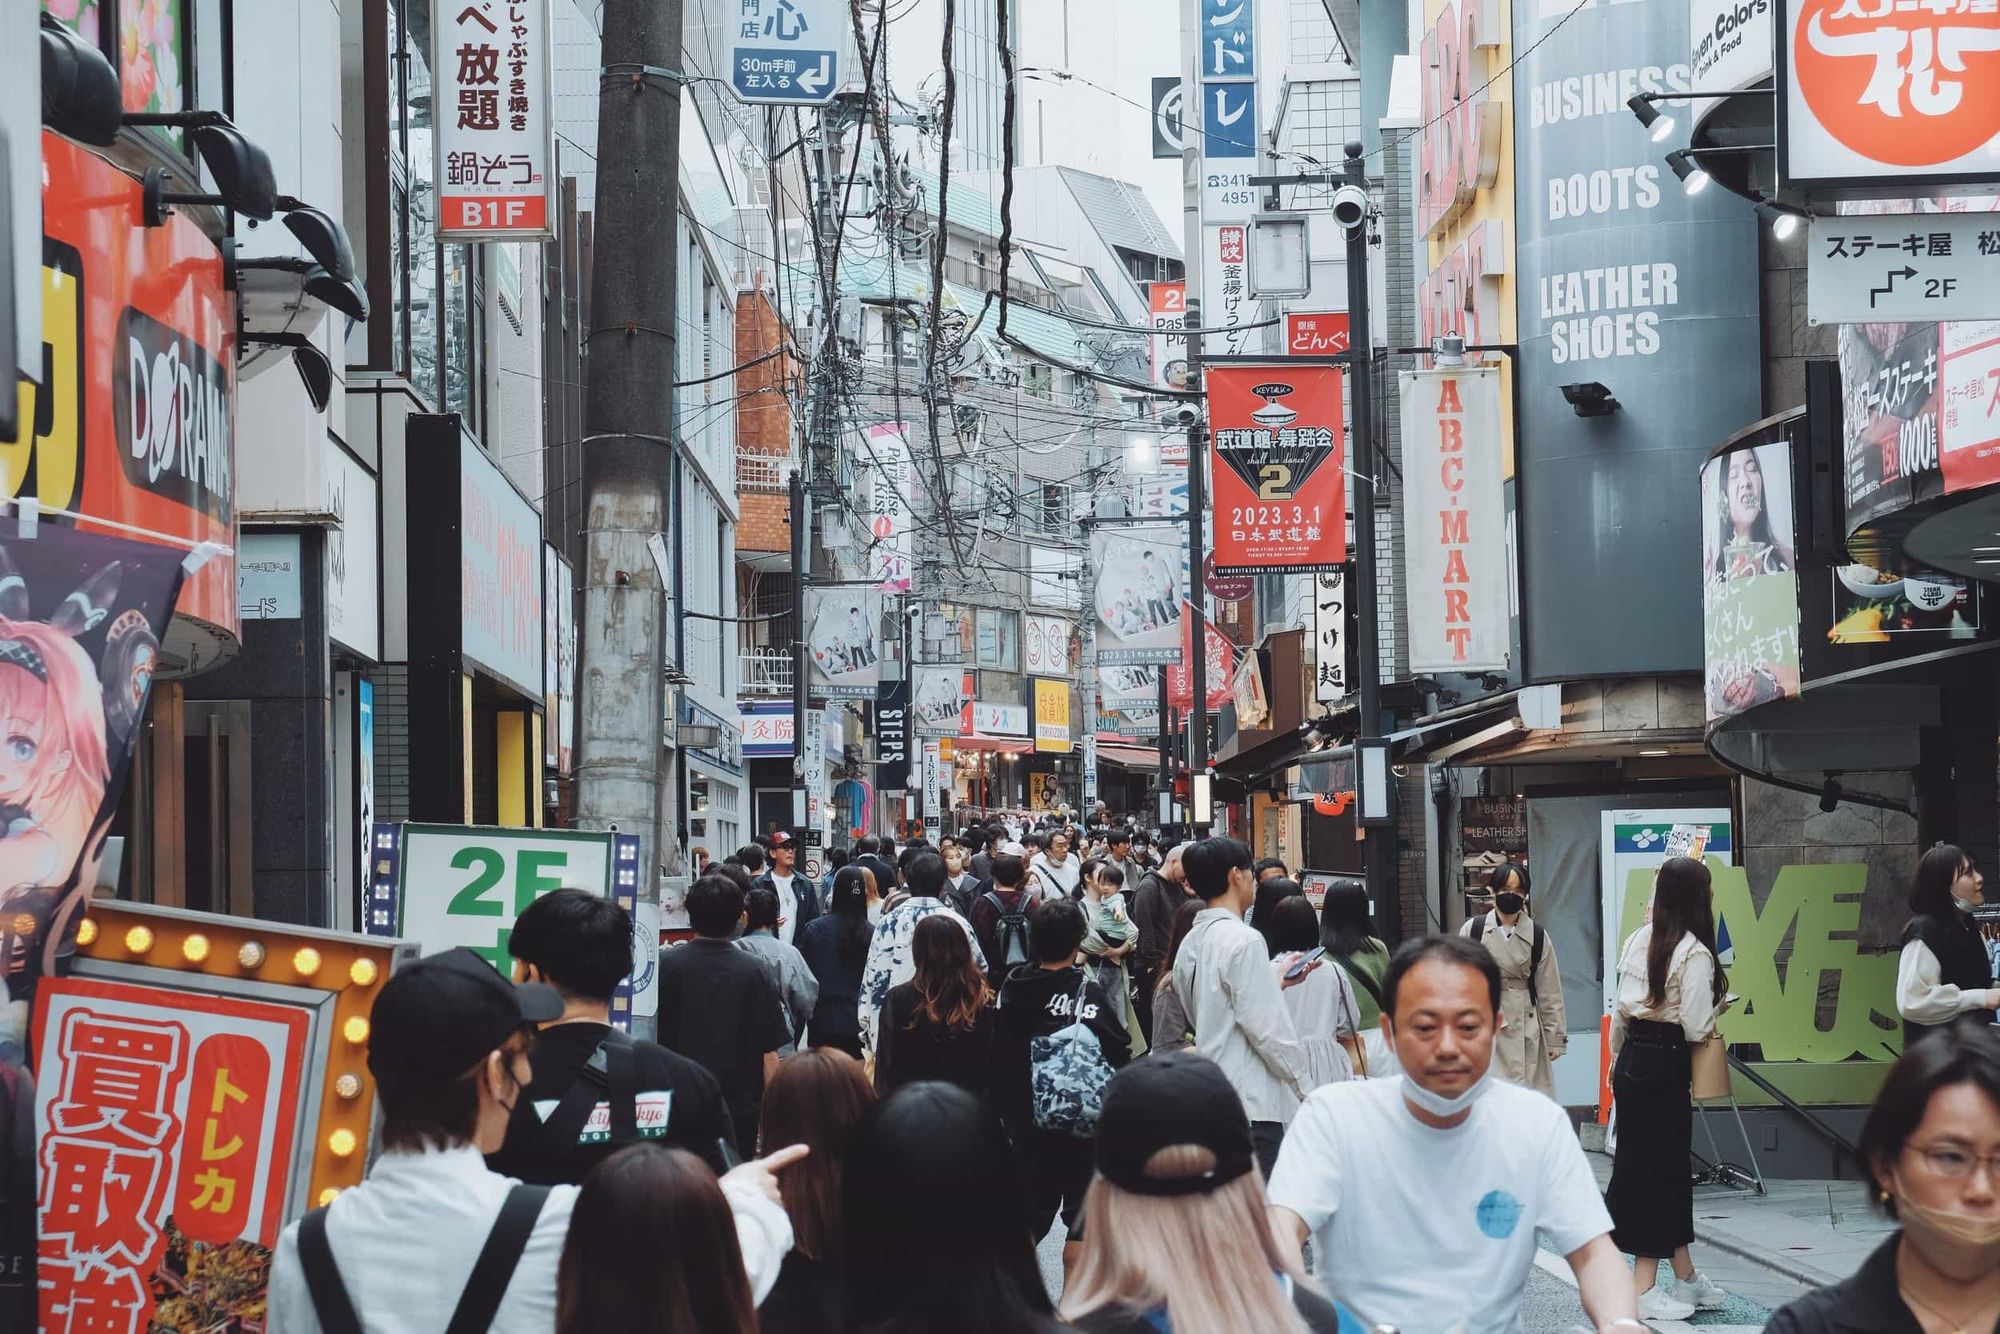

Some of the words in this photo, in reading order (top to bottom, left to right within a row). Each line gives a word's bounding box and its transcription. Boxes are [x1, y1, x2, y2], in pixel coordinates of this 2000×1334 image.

[1715, 0, 1767, 40] Colors
[1721, 32, 1741, 56] Food
[456, 2, 499, 130] べ放題
[741, 58, 796, 73] 30m手前
[745, 74, 790, 88] 左入る
[1531, 64, 1692, 129] BUSINESS
[448, 151, 532, 185] 鍋ぞう
[1221, 192, 1255, 204] 4951
[1550, 165, 1660, 220] BOOTS
[462, 201, 525, 226] B1F
[1826, 233, 1952, 258] ステーキ屋
[1541, 262, 1678, 319] LEATHER
[1925, 279, 1957, 298] 2F
[1156, 315, 1187, 329] Past
[1166, 332, 1187, 347] Piz
[1551, 311, 1660, 364] SHOES
[1216, 427, 1333, 450] 武道館で舞踏会
[1901, 413, 1931, 477] 1000
[1247, 451, 1267, 465] shall
[1270, 457, 1280, 465] we
[1283, 453, 1310, 465] dance?
[1259, 465, 1292, 500] 2
[874, 482, 887, 515] Kiss
[1232, 506, 1321, 526] 2023.3.1
[1437, 379, 1471, 661] ABC-MART
[1231, 527, 1321, 542] 日本武道館
[1319, 600, 1345, 687] つけ麺
[1177, 647, 1185, 695] HOTE
[741, 719, 794, 739] 灸院
[879, 709, 904, 762] STEPS
[1484, 803, 1525, 814] BUSINE
[1472, 827, 1513, 838] LEATHER
[446, 846, 568, 917] 2F
[189, 1067, 249, 1215] トレカ
